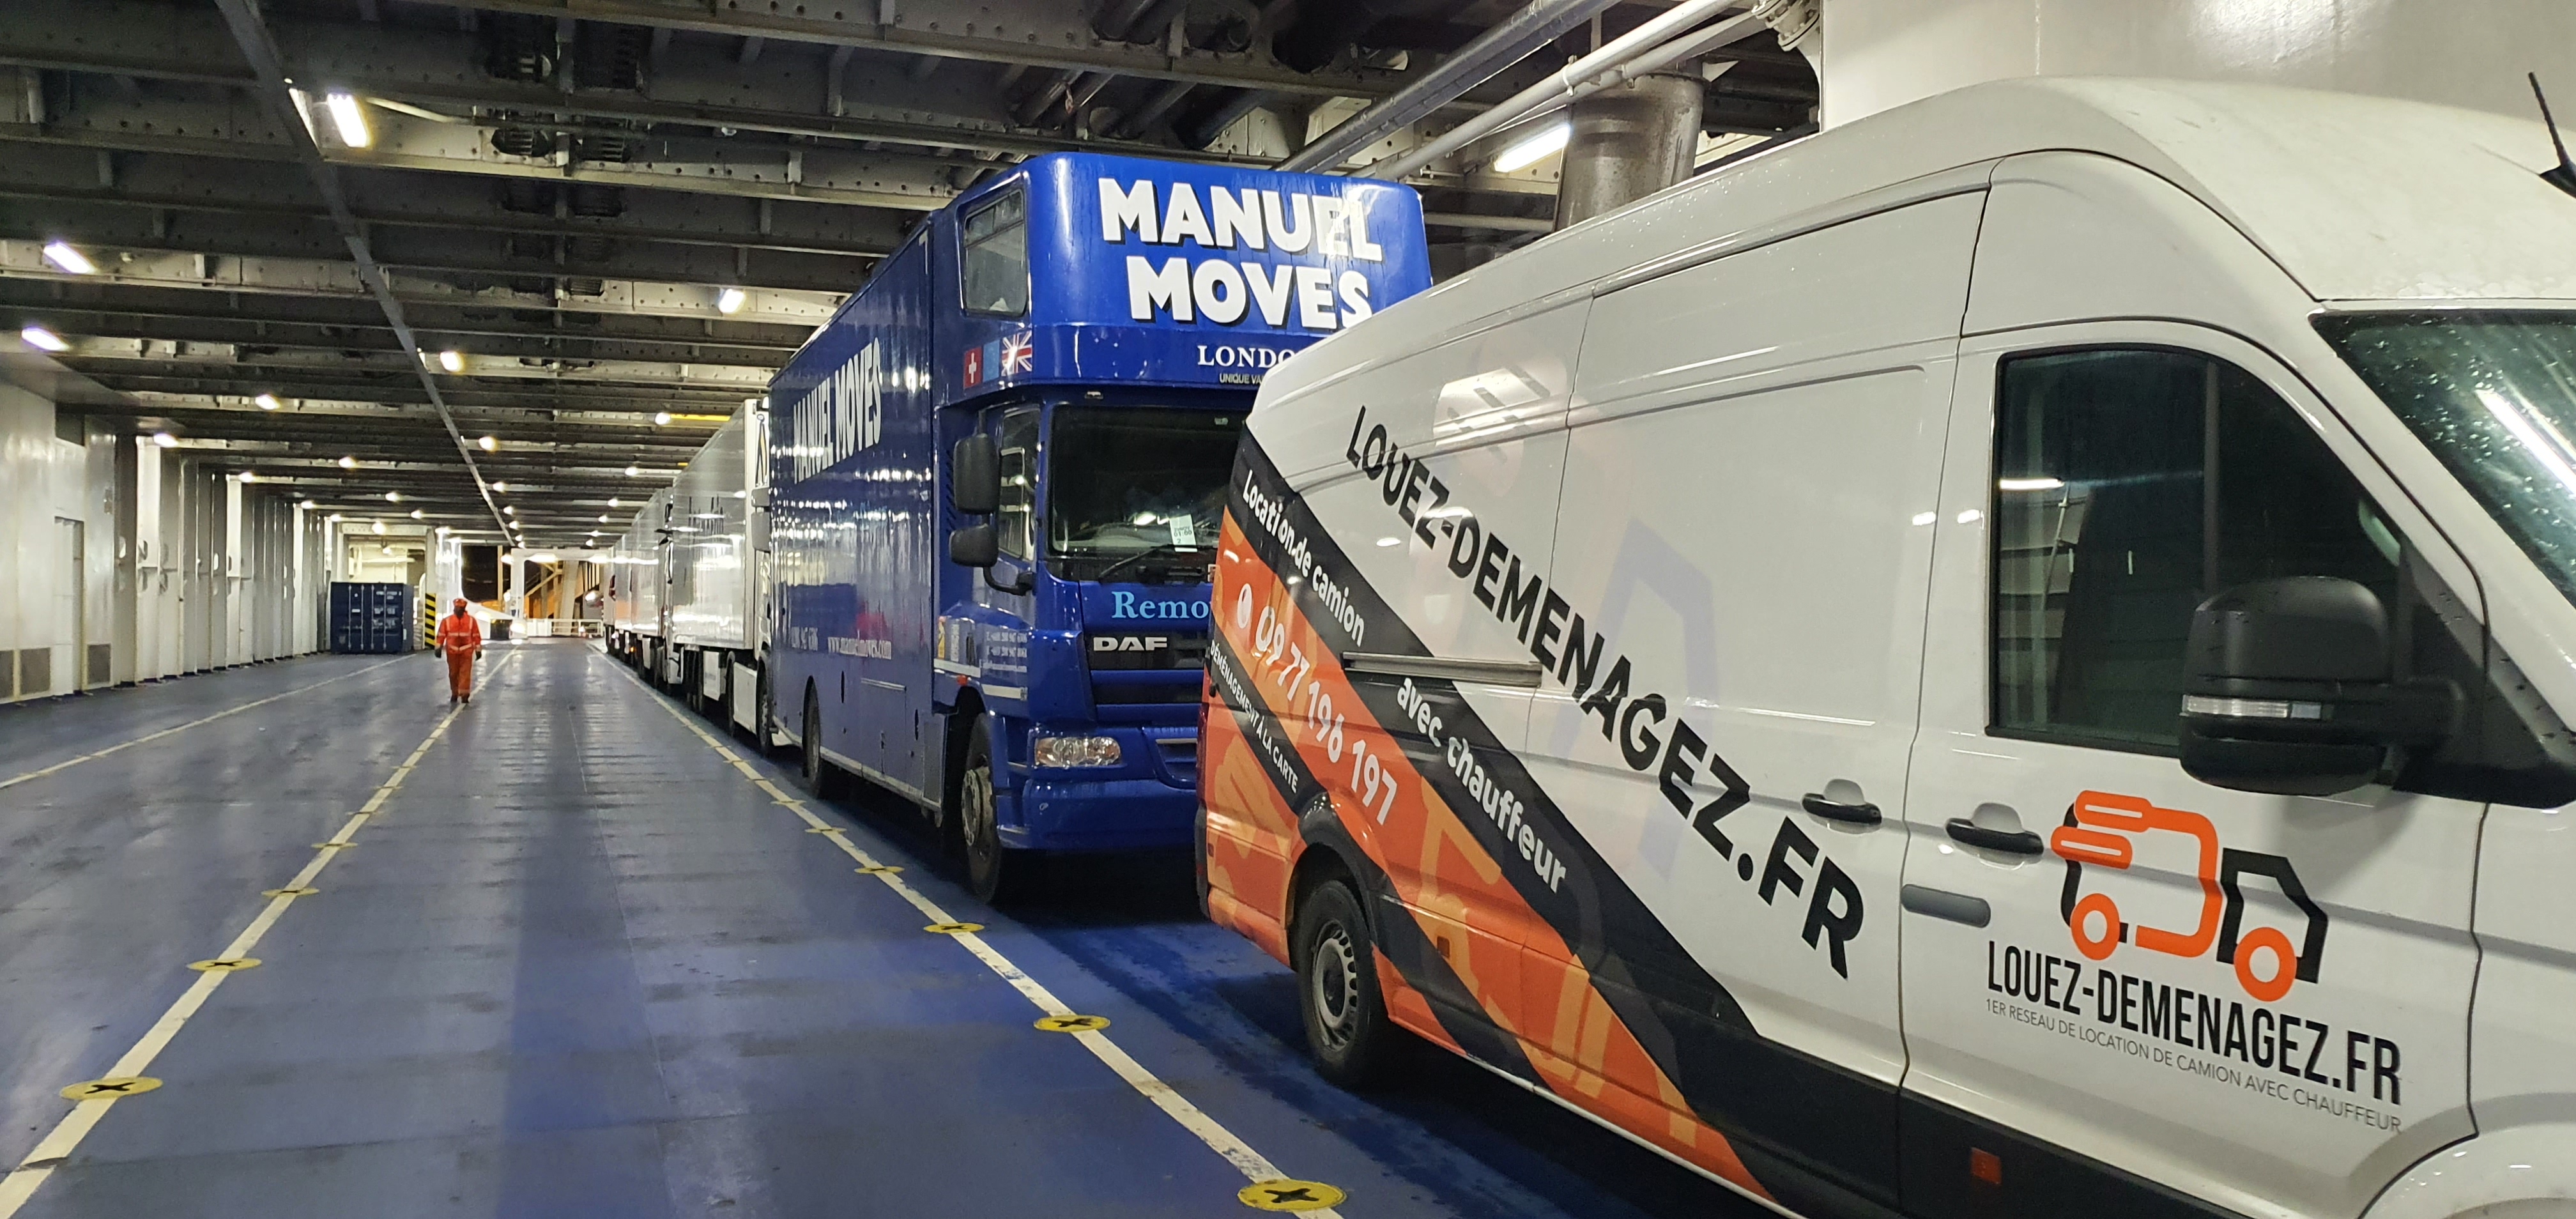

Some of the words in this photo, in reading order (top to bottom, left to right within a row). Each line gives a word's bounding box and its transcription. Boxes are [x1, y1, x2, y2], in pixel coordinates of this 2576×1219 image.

[1098, 177, 1383, 262] MANUEL
[1126, 256, 1372, 330] MOVES
[1197, 345, 1296, 368] LONDO
[793, 377, 834, 484] MANUEL
[835, 337, 881, 463] MOVES
[1219, 373, 1250, 383] UNIQUE
[1251, 374, 1264, 385] VA
[1093, 636, 1168, 652] DAF
[1112, 591, 1211, 619] Remo
[1210, 640, 1260, 728] DÉMÉNAGEMENT
[1256, 715, 1265, 739] À
[1262, 728, 1272, 756] LA
[1273, 746, 1298, 794] CARTE
[1242, 469, 1295, 553] Location
[1294, 537, 1312, 578] de
[1312, 565, 1365, 647] camion
[1397, 678, 1443, 747] avec
[1448, 737, 1567, 894] chauffeur
[1255, 606, 1285, 666] 09
[1277, 641, 1310, 702] 77
[1308, 680, 1345, 763] 196
[1351, 739, 1397, 825] 197
[1346, 405, 1864, 979] LOUEZ-DEMENAGEZ.FR
[1986, 998, 2006, 1016] 1ER
[2009, 1003, 2055, 1032] RESEAU
[2058, 1014, 2076, 1038] DE
[2079, 1024, 2149, 1060] LOCATION
[2154, 1047, 2173, 1067] DE
[2177, 1054, 2242, 1087] CAMION
[2244, 1075, 2290, 1101] AVEC
[2293, 1087, 2403, 1134] CHAUFFEUR
[1988, 940, 2402, 1105] LOUEZ-DEMENAGEZ.FR
